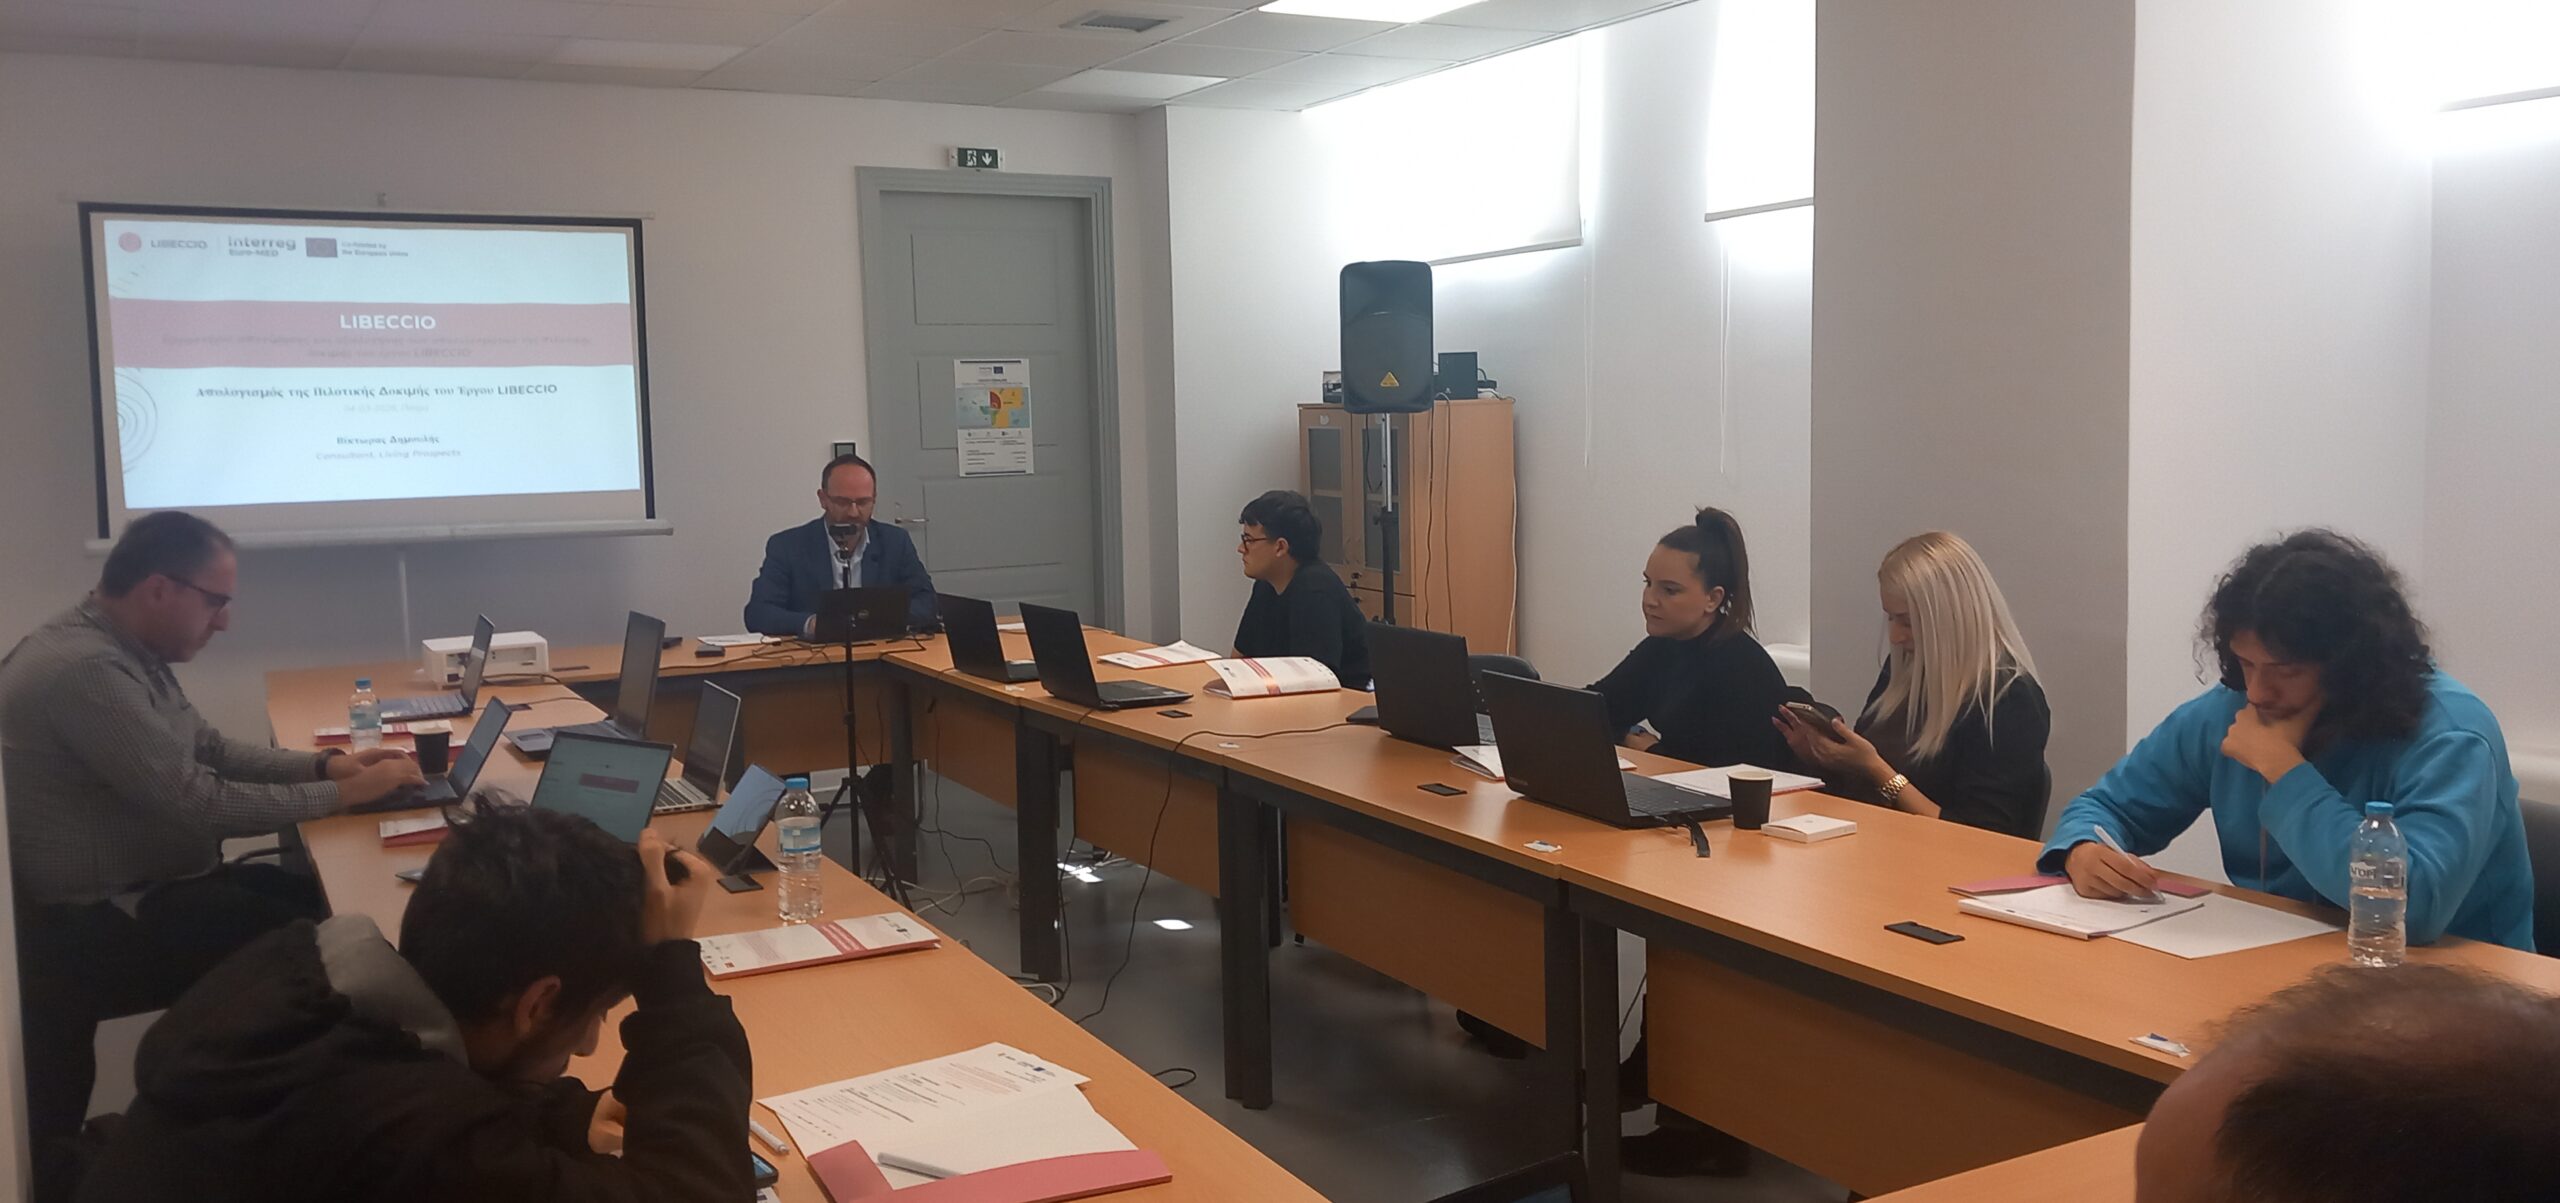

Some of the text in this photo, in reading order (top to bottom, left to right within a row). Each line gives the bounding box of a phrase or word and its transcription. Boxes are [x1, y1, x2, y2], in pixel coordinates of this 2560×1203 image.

[150, 239, 208, 249] LIBECCIO
[339, 314, 436, 330] LIBECCIO
[379, 384, 430, 397] Δοκιμής
[497, 384, 558, 395] LIBECCIO
